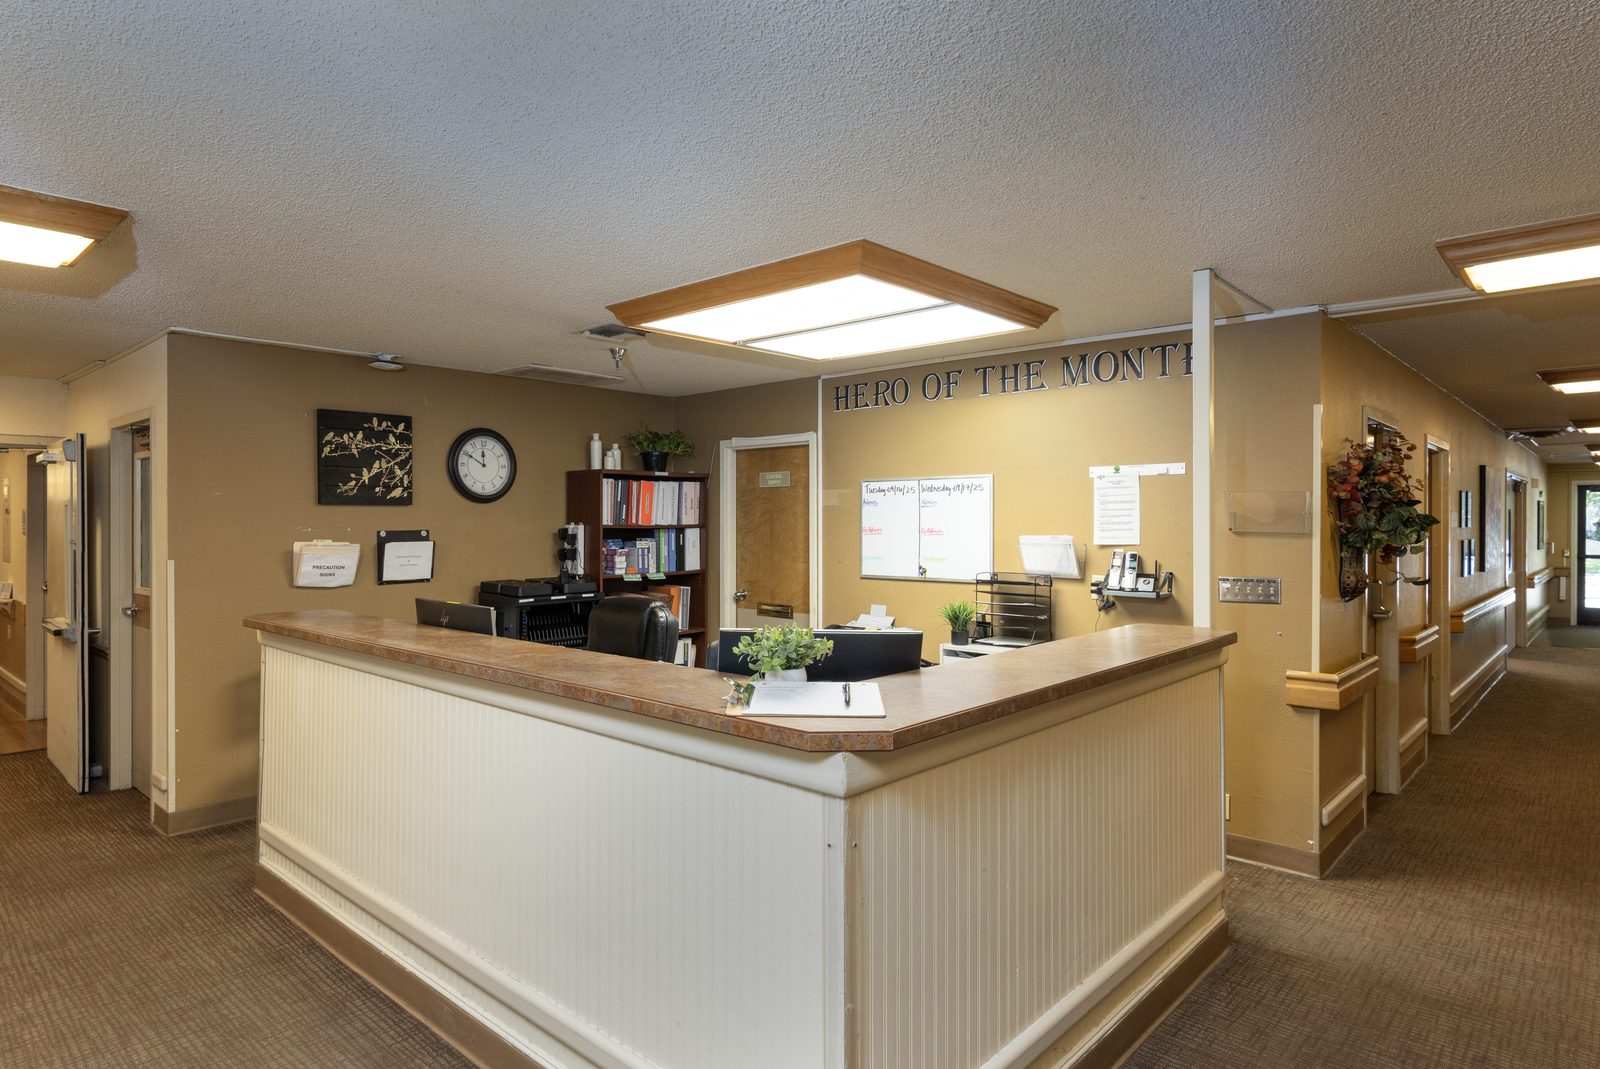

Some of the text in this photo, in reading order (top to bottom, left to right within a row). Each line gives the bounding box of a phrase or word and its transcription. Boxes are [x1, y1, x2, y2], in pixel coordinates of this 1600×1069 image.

[834, 377, 910, 412] HERO
[922, 369, 964, 402] OF
[974, 359, 1049, 397] THE
[864, 484, 887, 496] Tuesday
[921, 483, 951, 496] Wednesday
